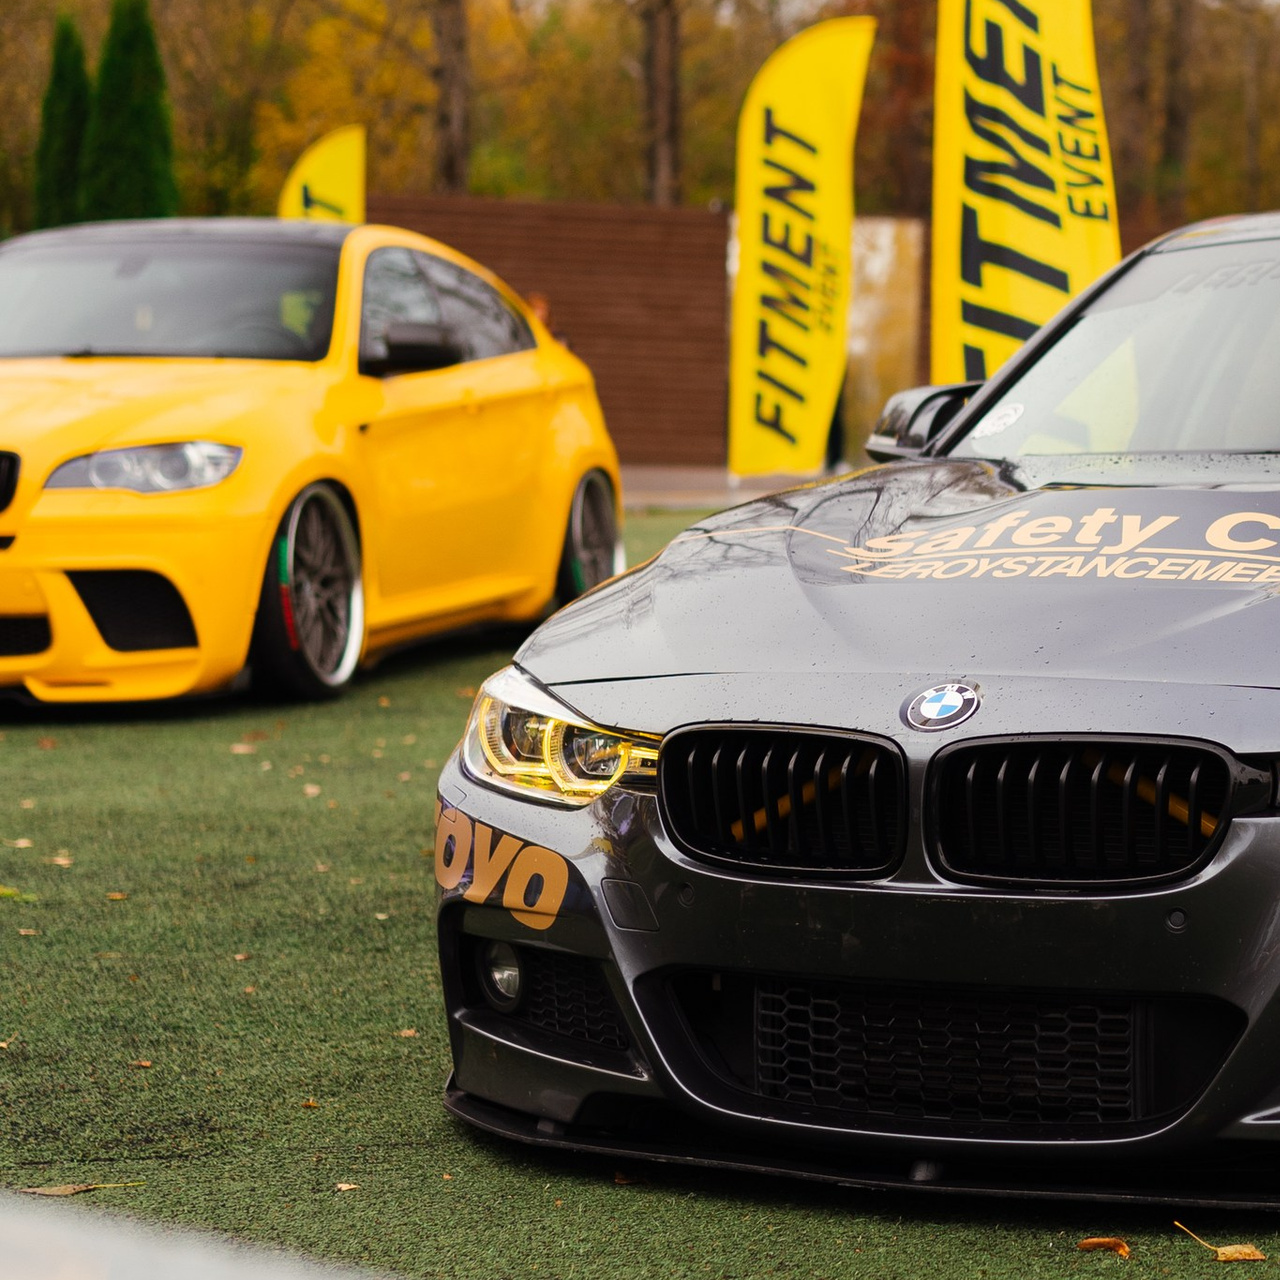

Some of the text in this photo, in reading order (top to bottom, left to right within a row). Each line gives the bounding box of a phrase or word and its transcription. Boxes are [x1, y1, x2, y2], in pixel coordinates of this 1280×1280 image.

[1051, 62, 1110, 222] EVENT
[754, 106, 818, 445] FITMENT
[844, 507, 1180, 560] Safety
[922, 685, 975, 699] BMW
